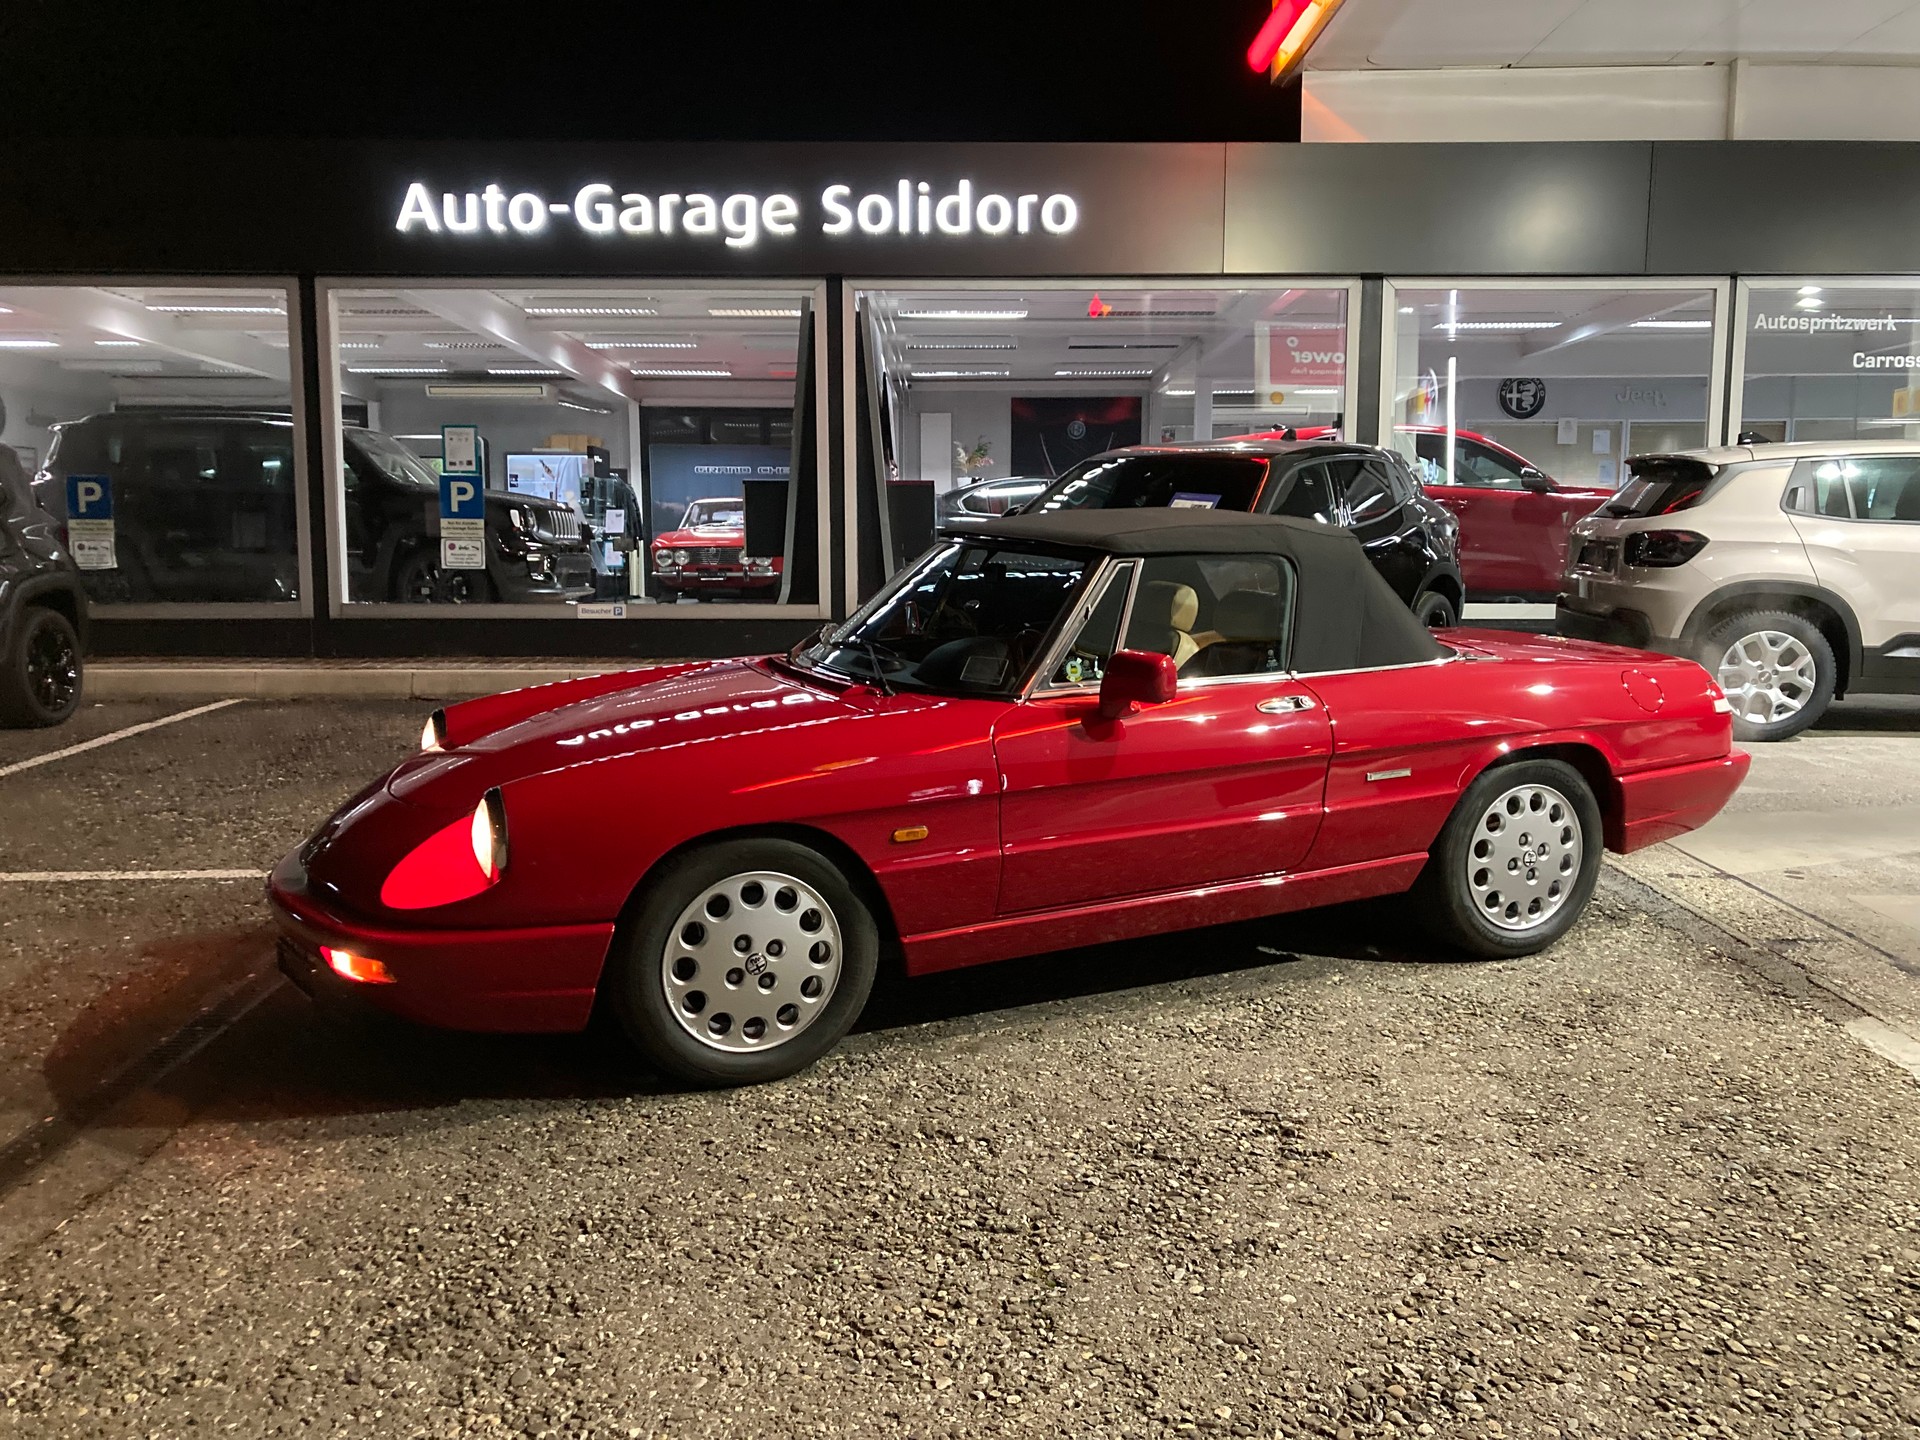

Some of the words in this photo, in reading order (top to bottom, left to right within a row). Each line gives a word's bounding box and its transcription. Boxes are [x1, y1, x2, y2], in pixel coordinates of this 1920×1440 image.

[396, 182, 799, 248] Auto-Garage
[820, 179, 1079, 236] Solidoro
[1754, 313, 1897, 334] Autospritzwerk
[1616, 386, 1667, 408] Jeep
[694, 465, 752, 474] GRAND
[77, 482, 102, 513] P
[450, 481, 475, 512] P
[581, 607, 612, 615] Besucher
